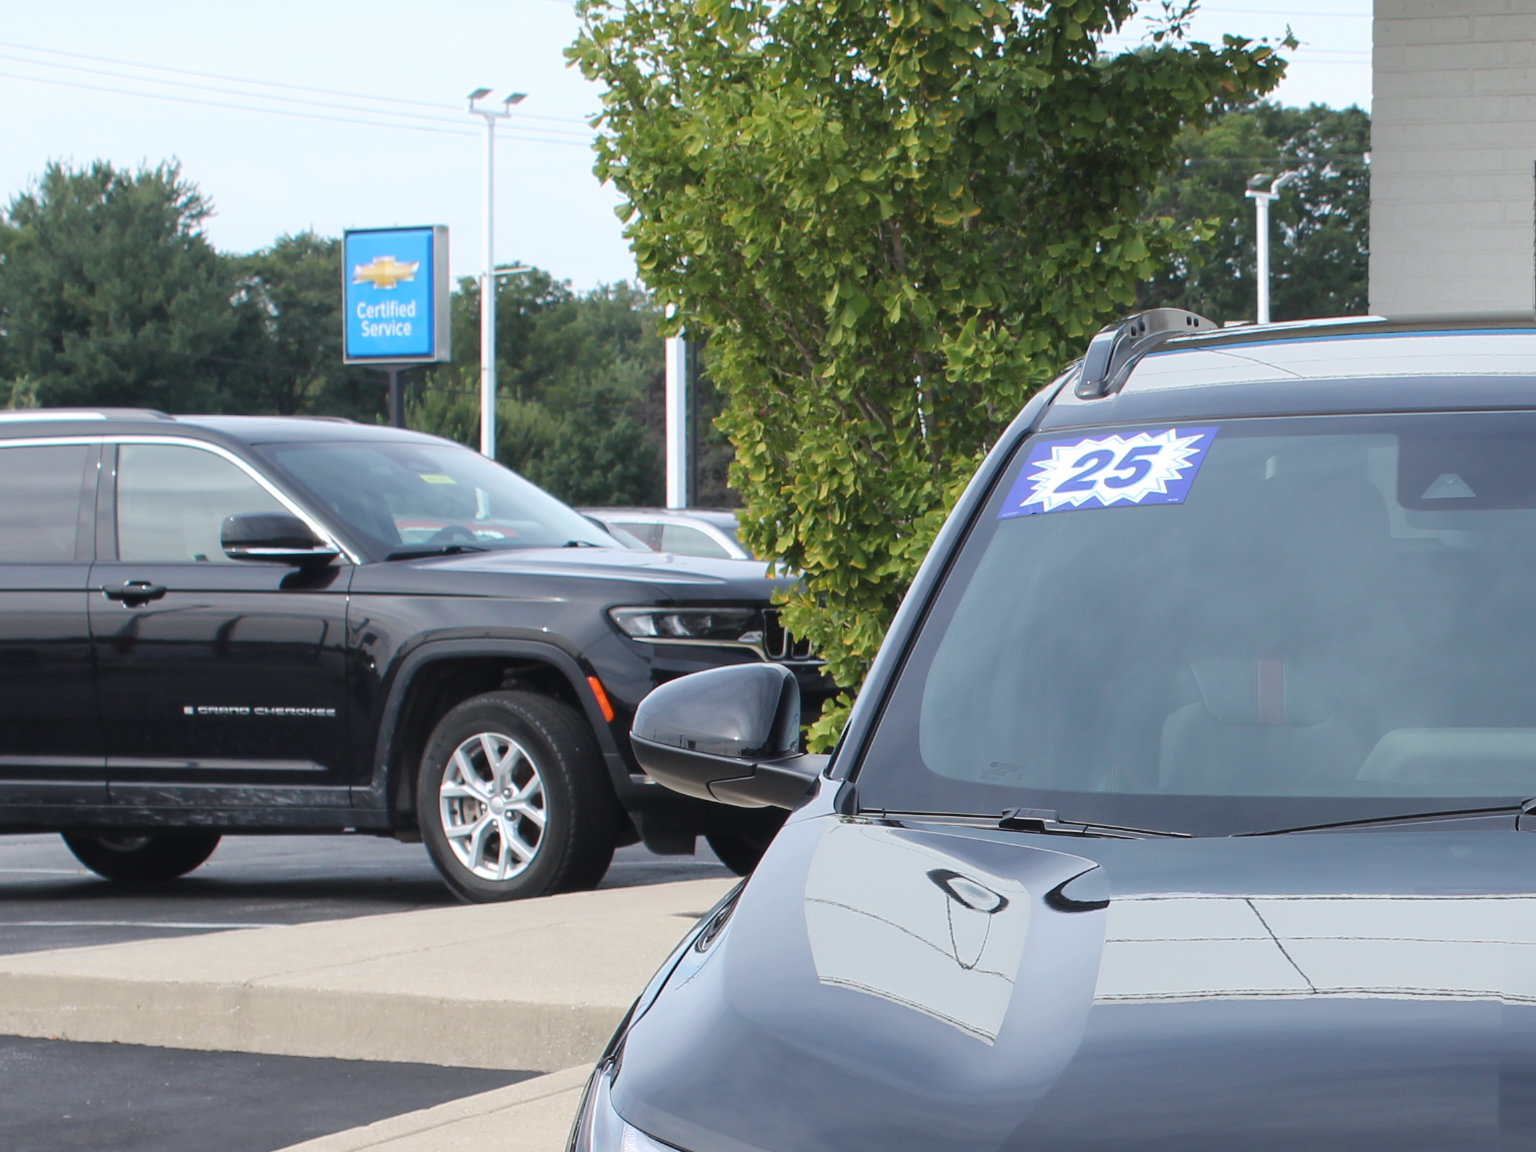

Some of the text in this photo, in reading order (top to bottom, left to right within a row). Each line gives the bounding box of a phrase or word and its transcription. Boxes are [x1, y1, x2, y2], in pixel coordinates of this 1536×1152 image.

[356, 300, 417, 319] Certified
[360, 320, 412, 337] Service
[1052, 444, 1163, 494] 25
[197, 706, 336, 717] GRAND CHEROKEE
